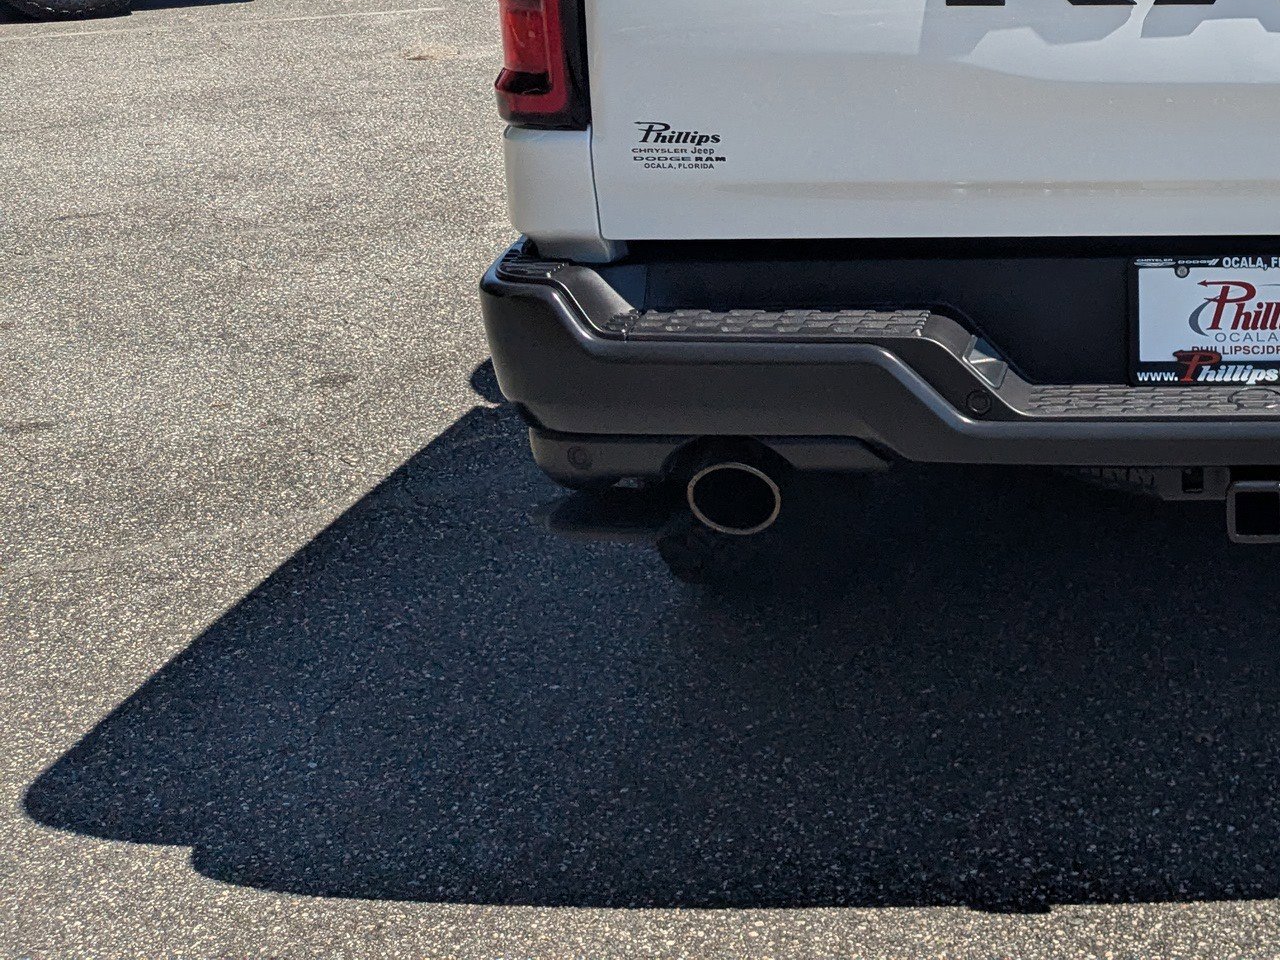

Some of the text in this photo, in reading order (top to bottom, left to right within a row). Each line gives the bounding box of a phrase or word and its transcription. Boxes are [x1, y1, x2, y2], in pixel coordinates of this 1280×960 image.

[634, 121, 721, 146] Phillips
[691, 147, 715, 155] Jeep
[1222, 256, 1268, 270] OCALA,
[1215, 332, 1279, 343] OCALA
